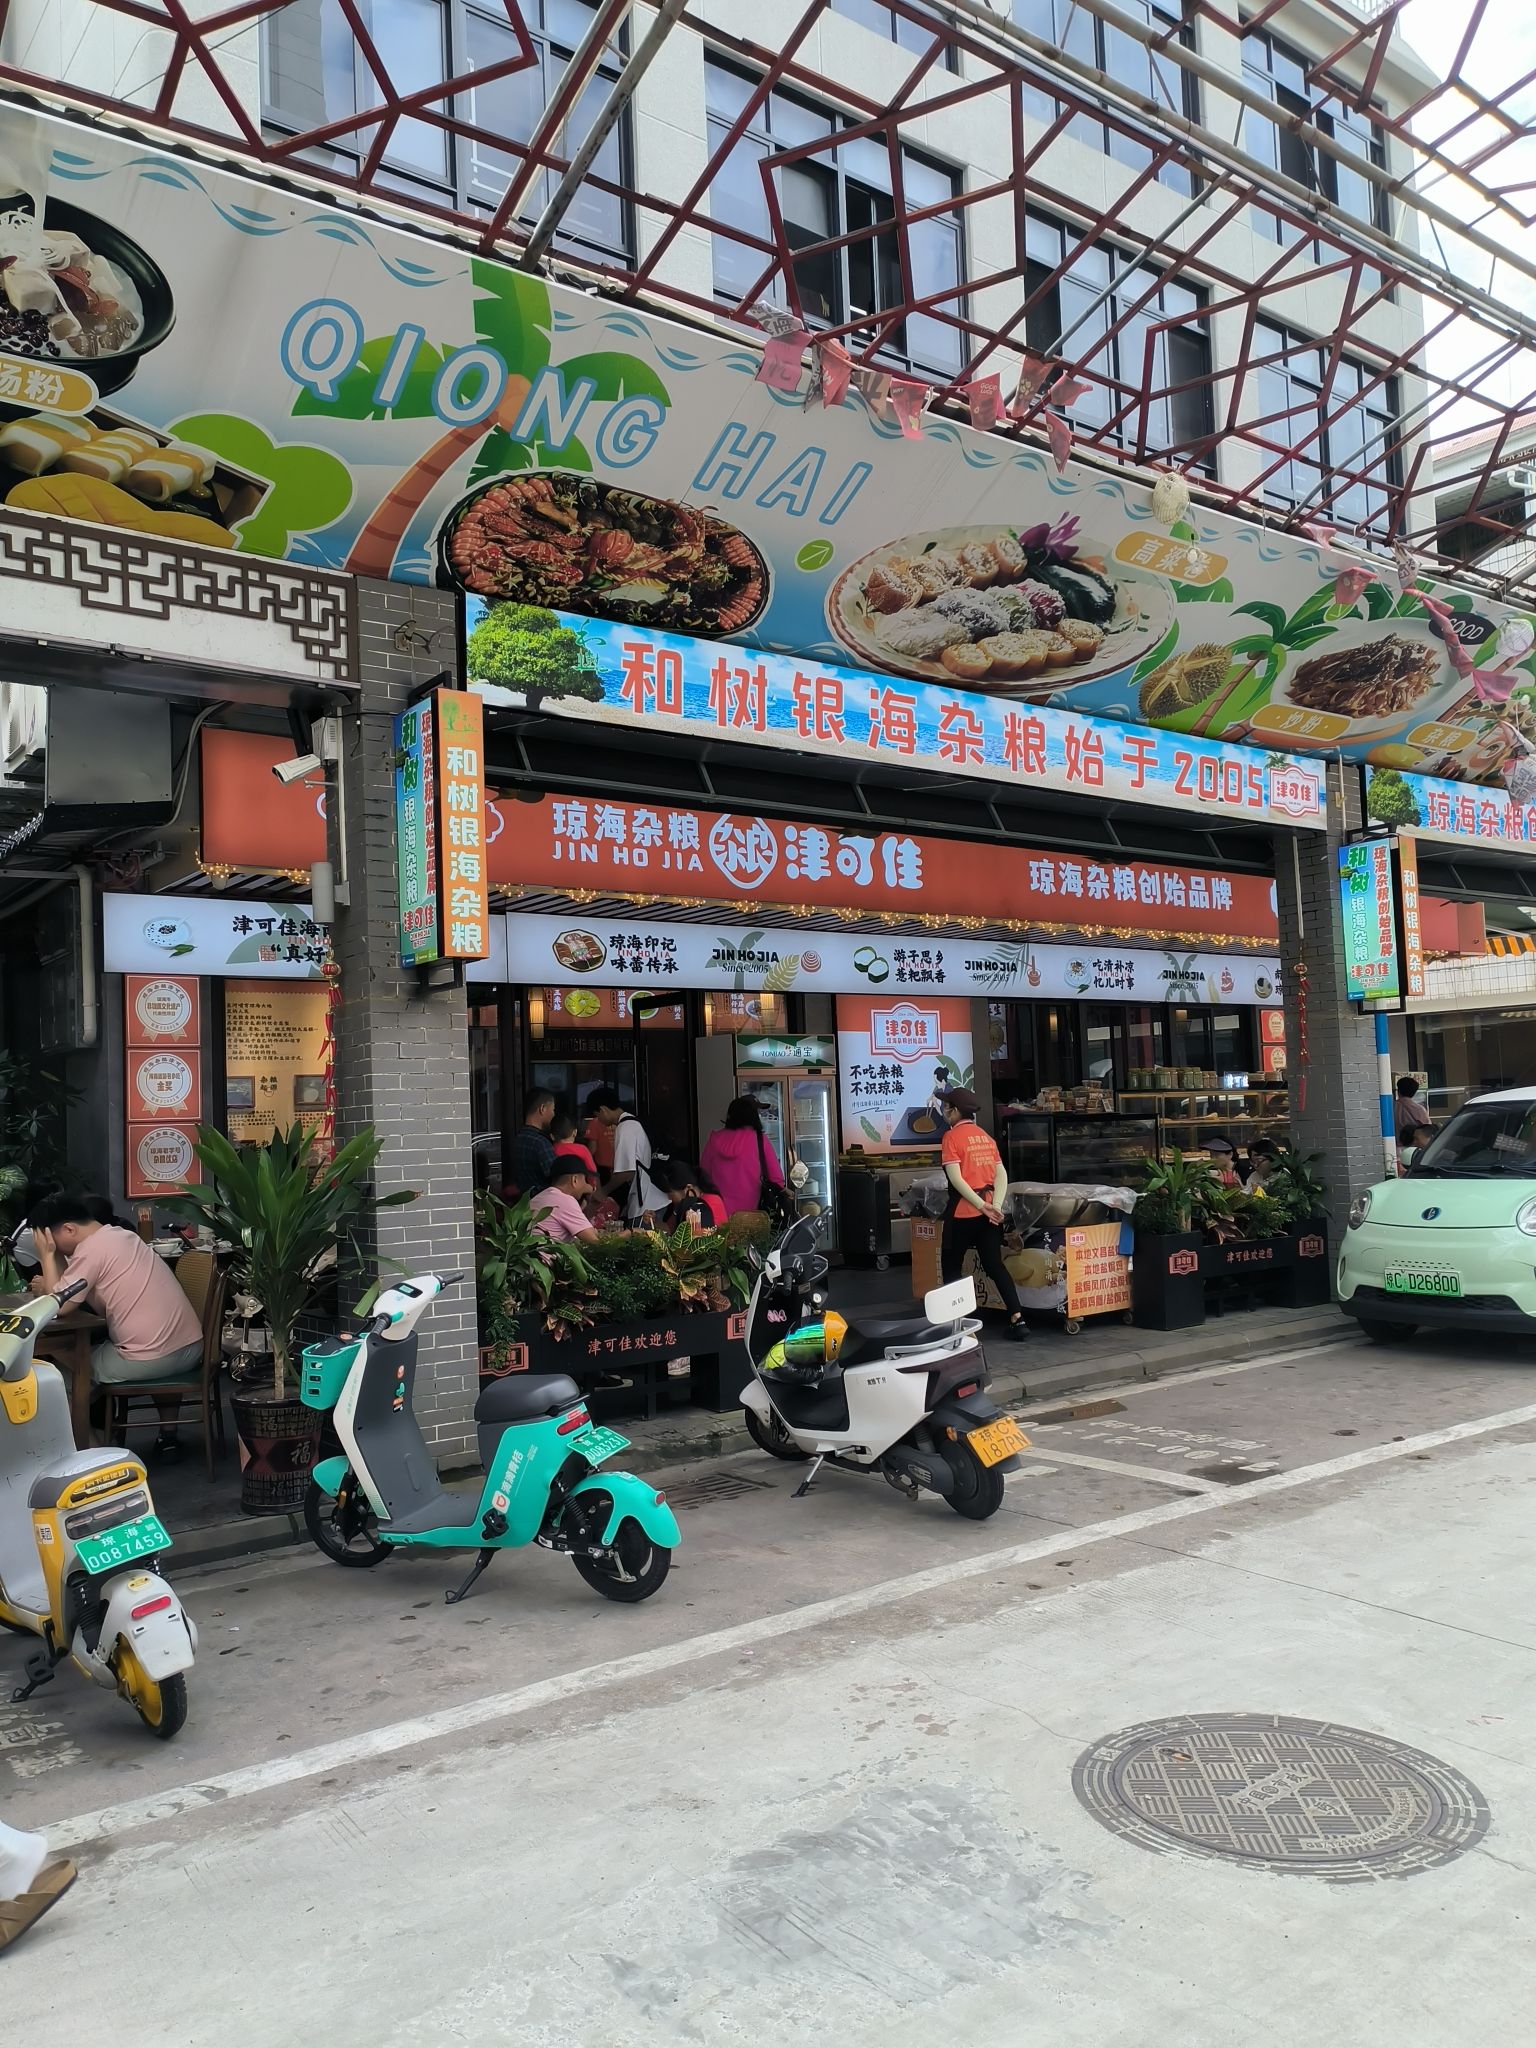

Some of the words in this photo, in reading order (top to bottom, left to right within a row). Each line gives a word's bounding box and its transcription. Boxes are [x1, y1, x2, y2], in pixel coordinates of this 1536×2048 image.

[280, 299, 666, 468] QIONG
[692, 422, 873, 525] HAI
[1276, 780, 1312, 802] 津可佳
[552, 801, 701, 850] 琼海杂粮
[446, 746, 483, 954] 和树银海杂粮
[552, 841, 598, 863] JIN
[613, 846, 649, 867] HO
[662, 851, 704, 872] JIA
[784, 825, 923, 889] 津可佳
[1028, 858, 1233, 911] 琼海杂粮创始品牌
[1373, 845, 1393, 957] 琼海杂粮创始品牌
[403, 903, 434, 932] 津可佳
[1403, 869, 1423, 994] 和树银海杂粮
[609, 934, 677, 952] 琼海印记
[610, 956, 680, 974] 味蕾传承
[712, 949, 735, 961] JIN
[737, 950, 755, 962] HO
[756, 951, 779, 963] JIA
[893, 948, 944, 964] 游子思乡
[1092, 958, 1135, 972] 吃清补凉
[722, 962, 746, 973] Since
[748, 963, 769, 974] 2005
[895, 968, 946, 984] 薏粑飘香
[965, 960, 983, 971] JIN
[984, 961, 999, 972] HO
[1000, 961, 1018, 973] JIA
[1163, 970, 1178, 979] JIN
[1179, 970, 1190, 980] HO
[1191, 971, 1206, 981] JIA
[1350, 962, 1389, 979] 津可佳
[885, 1019, 928, 1037] 津可佳
[849, 1063, 905, 1080] 不吃杂粮
[850, 1080, 905, 1097] 不识琼海
[1408, 1273, 1458, 1293] D26800
[588, 1329, 678, 1357] 津可佳欢迎您
[982, 1433, 1031, 1462] 187PN
[88, 1531, 164, 1569] 0087459
